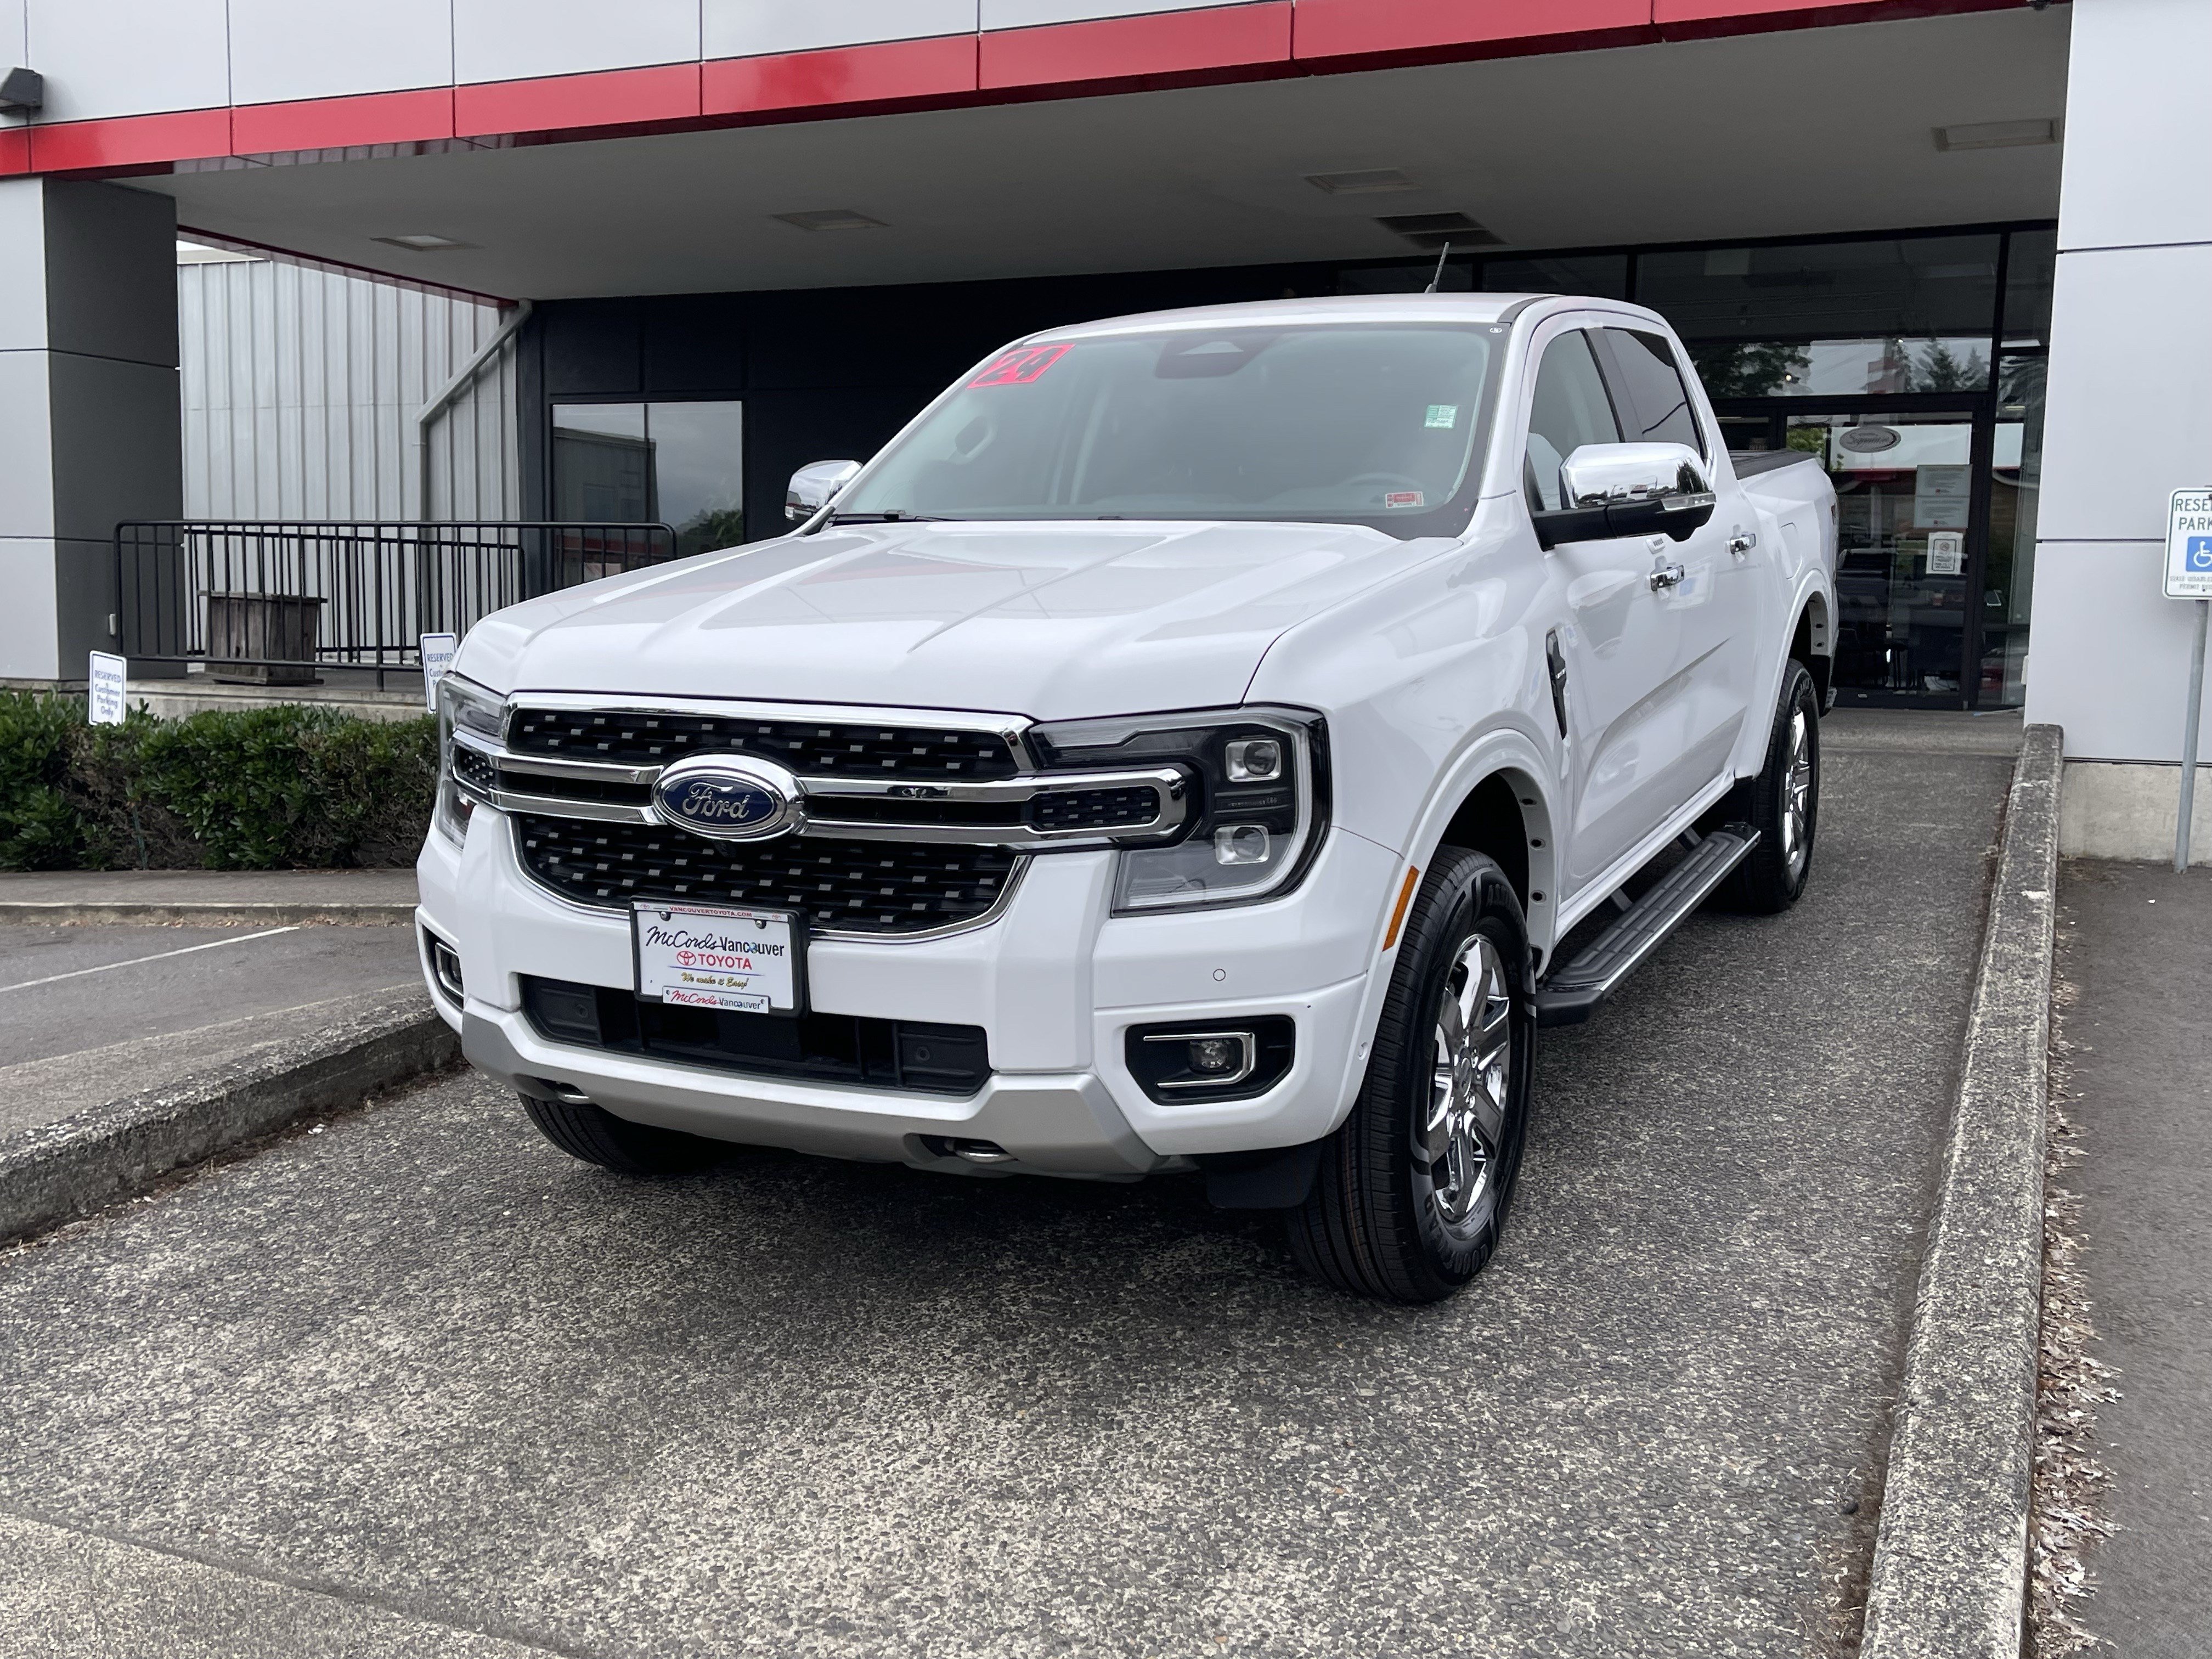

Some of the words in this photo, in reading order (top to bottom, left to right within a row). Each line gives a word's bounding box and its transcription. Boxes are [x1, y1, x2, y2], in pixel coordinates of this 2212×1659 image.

[2175, 498, 2212, 512] RESE
[427, 653, 454, 662] RESERVED
[94, 670, 121, 683] RESERVED
[97, 695, 118, 709] Parking
[101, 706, 114, 718] Only
[682, 782, 751, 819] Ford
[669, 906, 753, 918] VANCOUVERTOYOTA.COM
[697, 953, 753, 970] TOYOTA
[681, 972, 695, 983] We
[696, 974, 716, 985] make
[725, 977, 749, 990] Easy!
